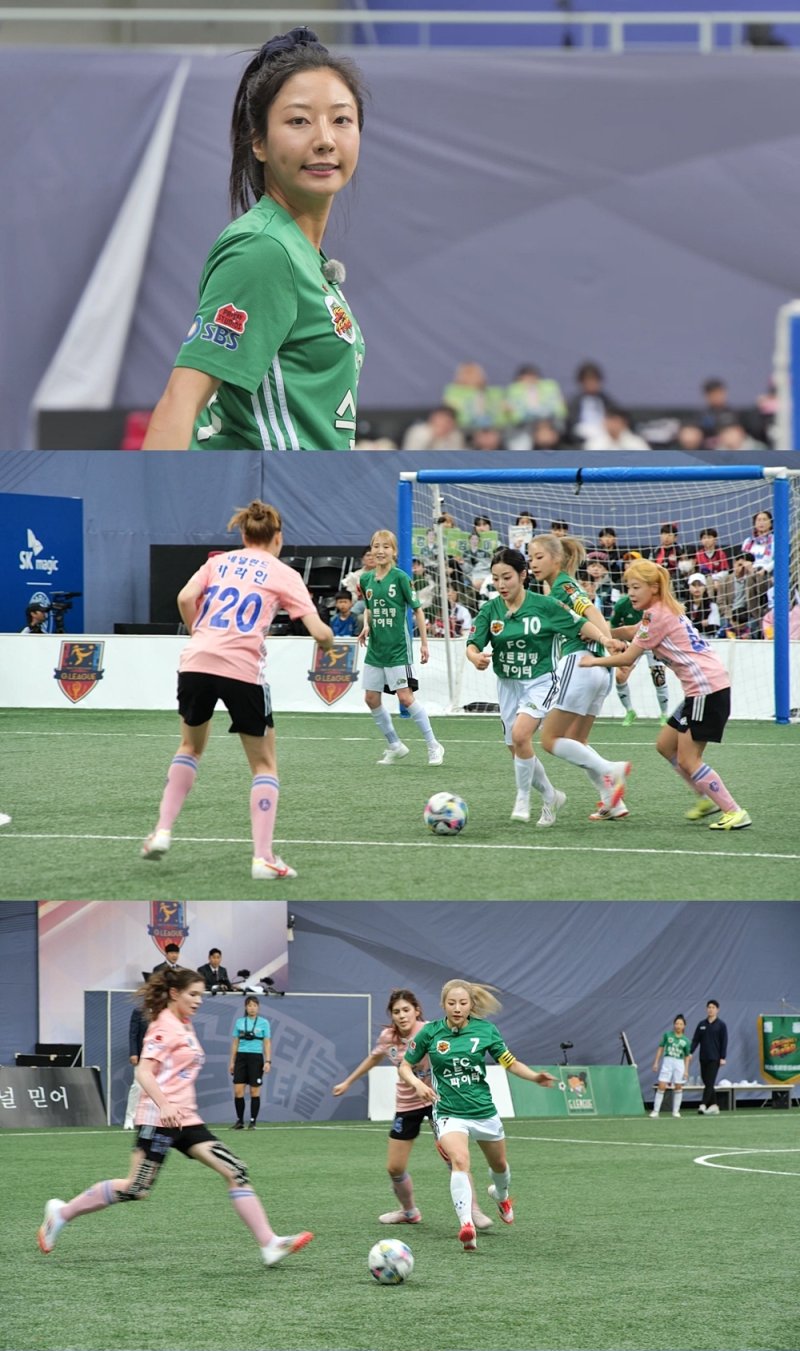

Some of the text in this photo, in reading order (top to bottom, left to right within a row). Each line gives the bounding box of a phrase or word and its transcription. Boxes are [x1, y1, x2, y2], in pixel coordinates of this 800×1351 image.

[201, 322, 240, 351] SBS
[19, 551, 59, 575] SK magic
[388, 584, 397, 598] 5
[373, 599, 386, 607] FC
[372, 607, 397, 617] 트리밍
[522, 616, 541, 635] 10
[506, 639, 527, 650] FC
[502, 664, 533, 678] 파이터
[470, 1037, 480, 1053] 7
[453, 1057, 470, 1067] FC
[0, 1086, 69, 1110] 널 믿어
